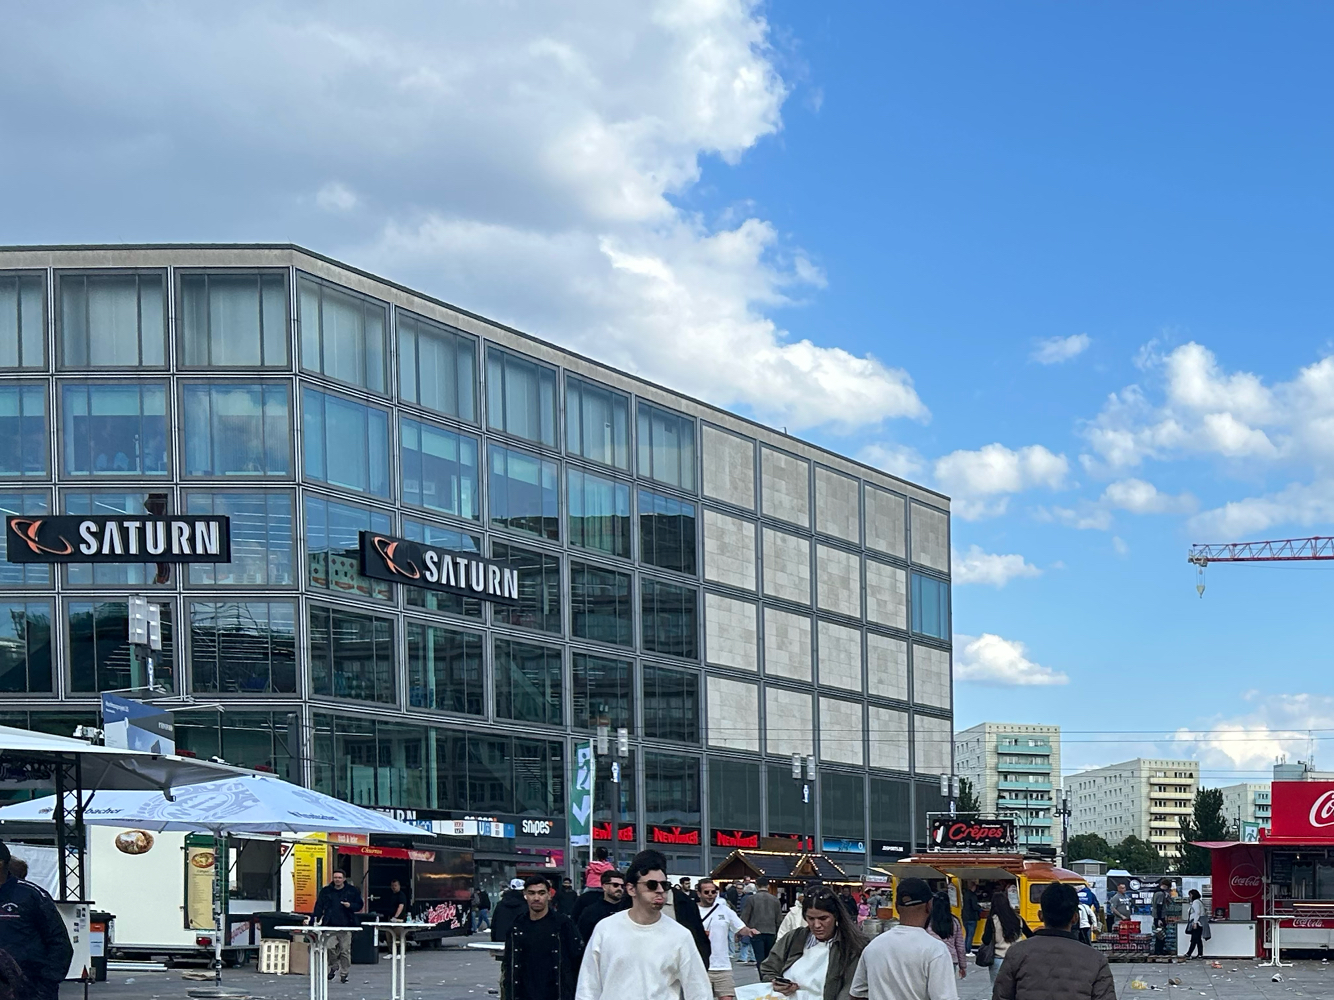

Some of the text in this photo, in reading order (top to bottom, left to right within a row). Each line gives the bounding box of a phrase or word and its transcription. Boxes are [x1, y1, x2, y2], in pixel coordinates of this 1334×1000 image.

[79, 520, 221, 556] SATURN
[423, 550, 519, 600] SATURN
[948, 823, 1005, 841] Crêpes
